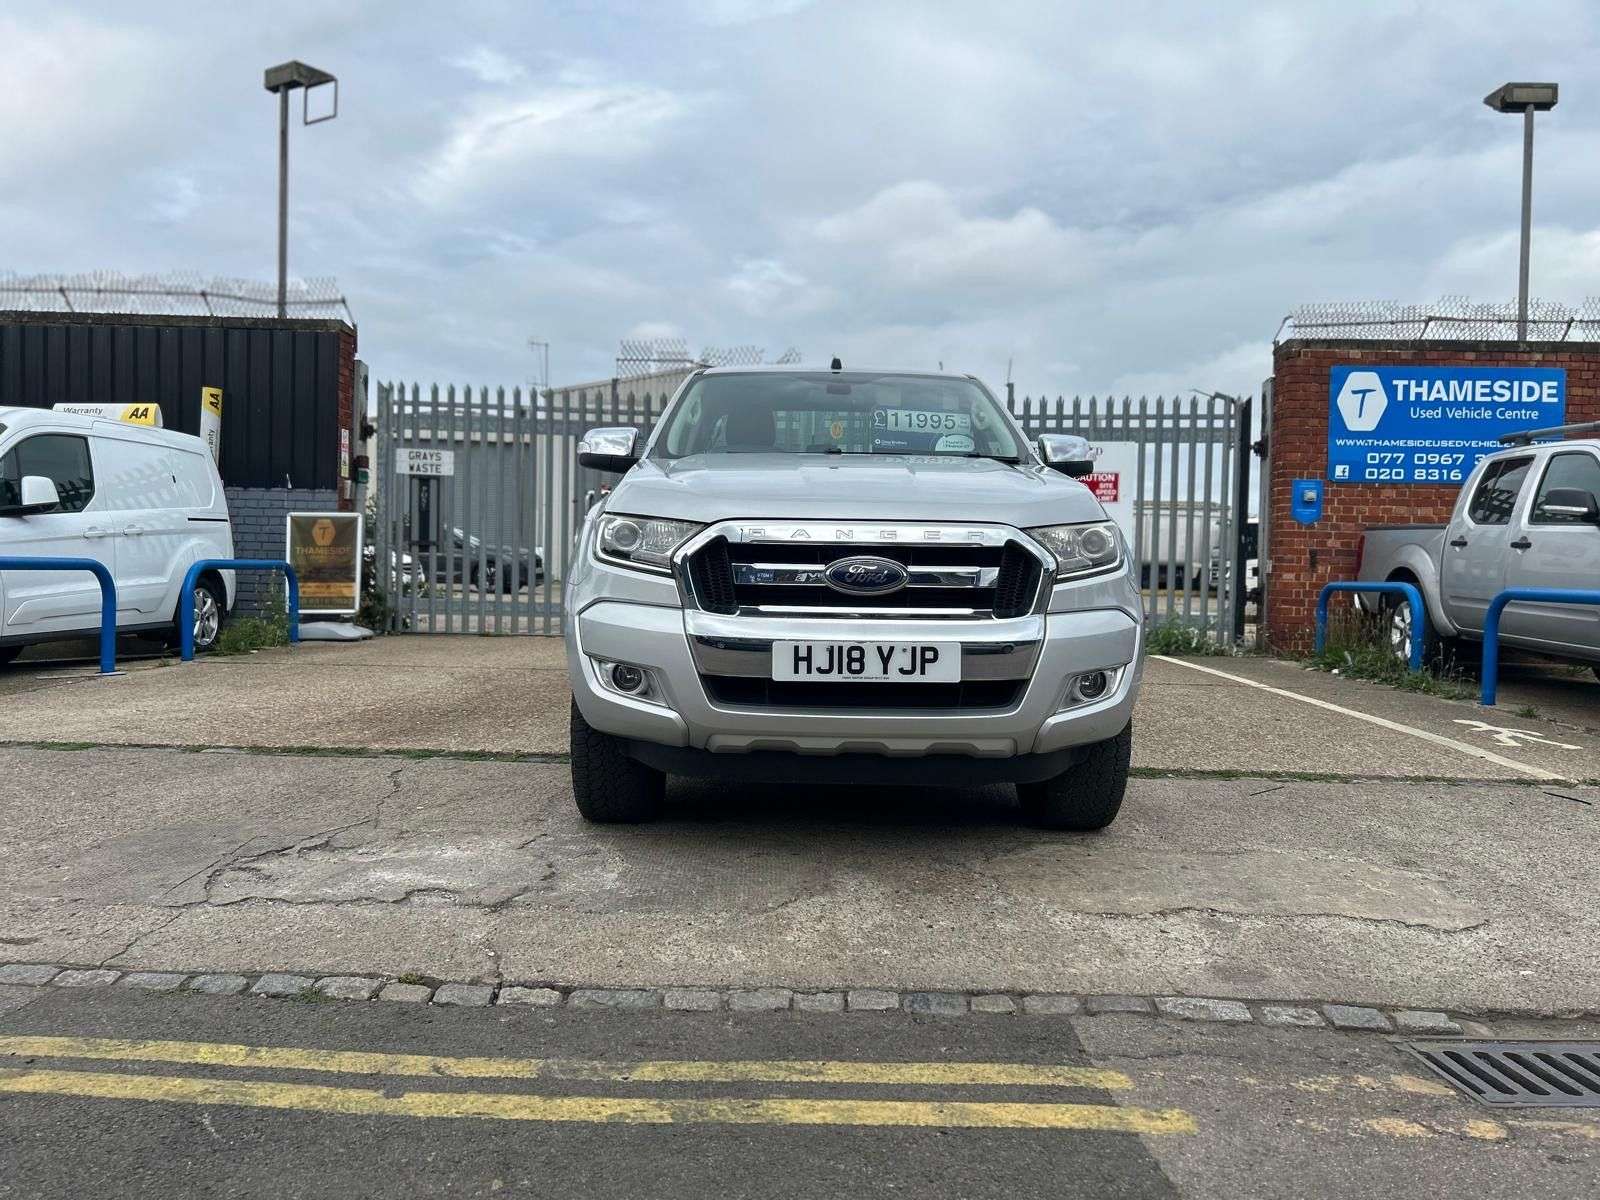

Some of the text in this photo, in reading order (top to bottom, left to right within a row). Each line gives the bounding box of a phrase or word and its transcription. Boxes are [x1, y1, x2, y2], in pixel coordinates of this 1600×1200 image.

[1392, 379, 1559, 403] THAMESIDE
[209, 392, 220, 410] AA
[1351, 388, 1377, 419] T
[63, 406, 104, 416] Warranty
[128, 407, 149, 420] AA
[1410, 407, 1539, 420] Used Vehicle Centre
[408, 450, 442, 461] GRAYS
[1366, 453, 1405, 464] 077
[1414, 453, 1465, 465] 0967
[408, 463, 442, 474] WASTE
[1365, 468, 1462, 480] 020 8316
[749, 528, 985, 541] RANGER
[844, 563, 887, 584] Ford
[793, 645, 939, 676] HJ18 YJP
